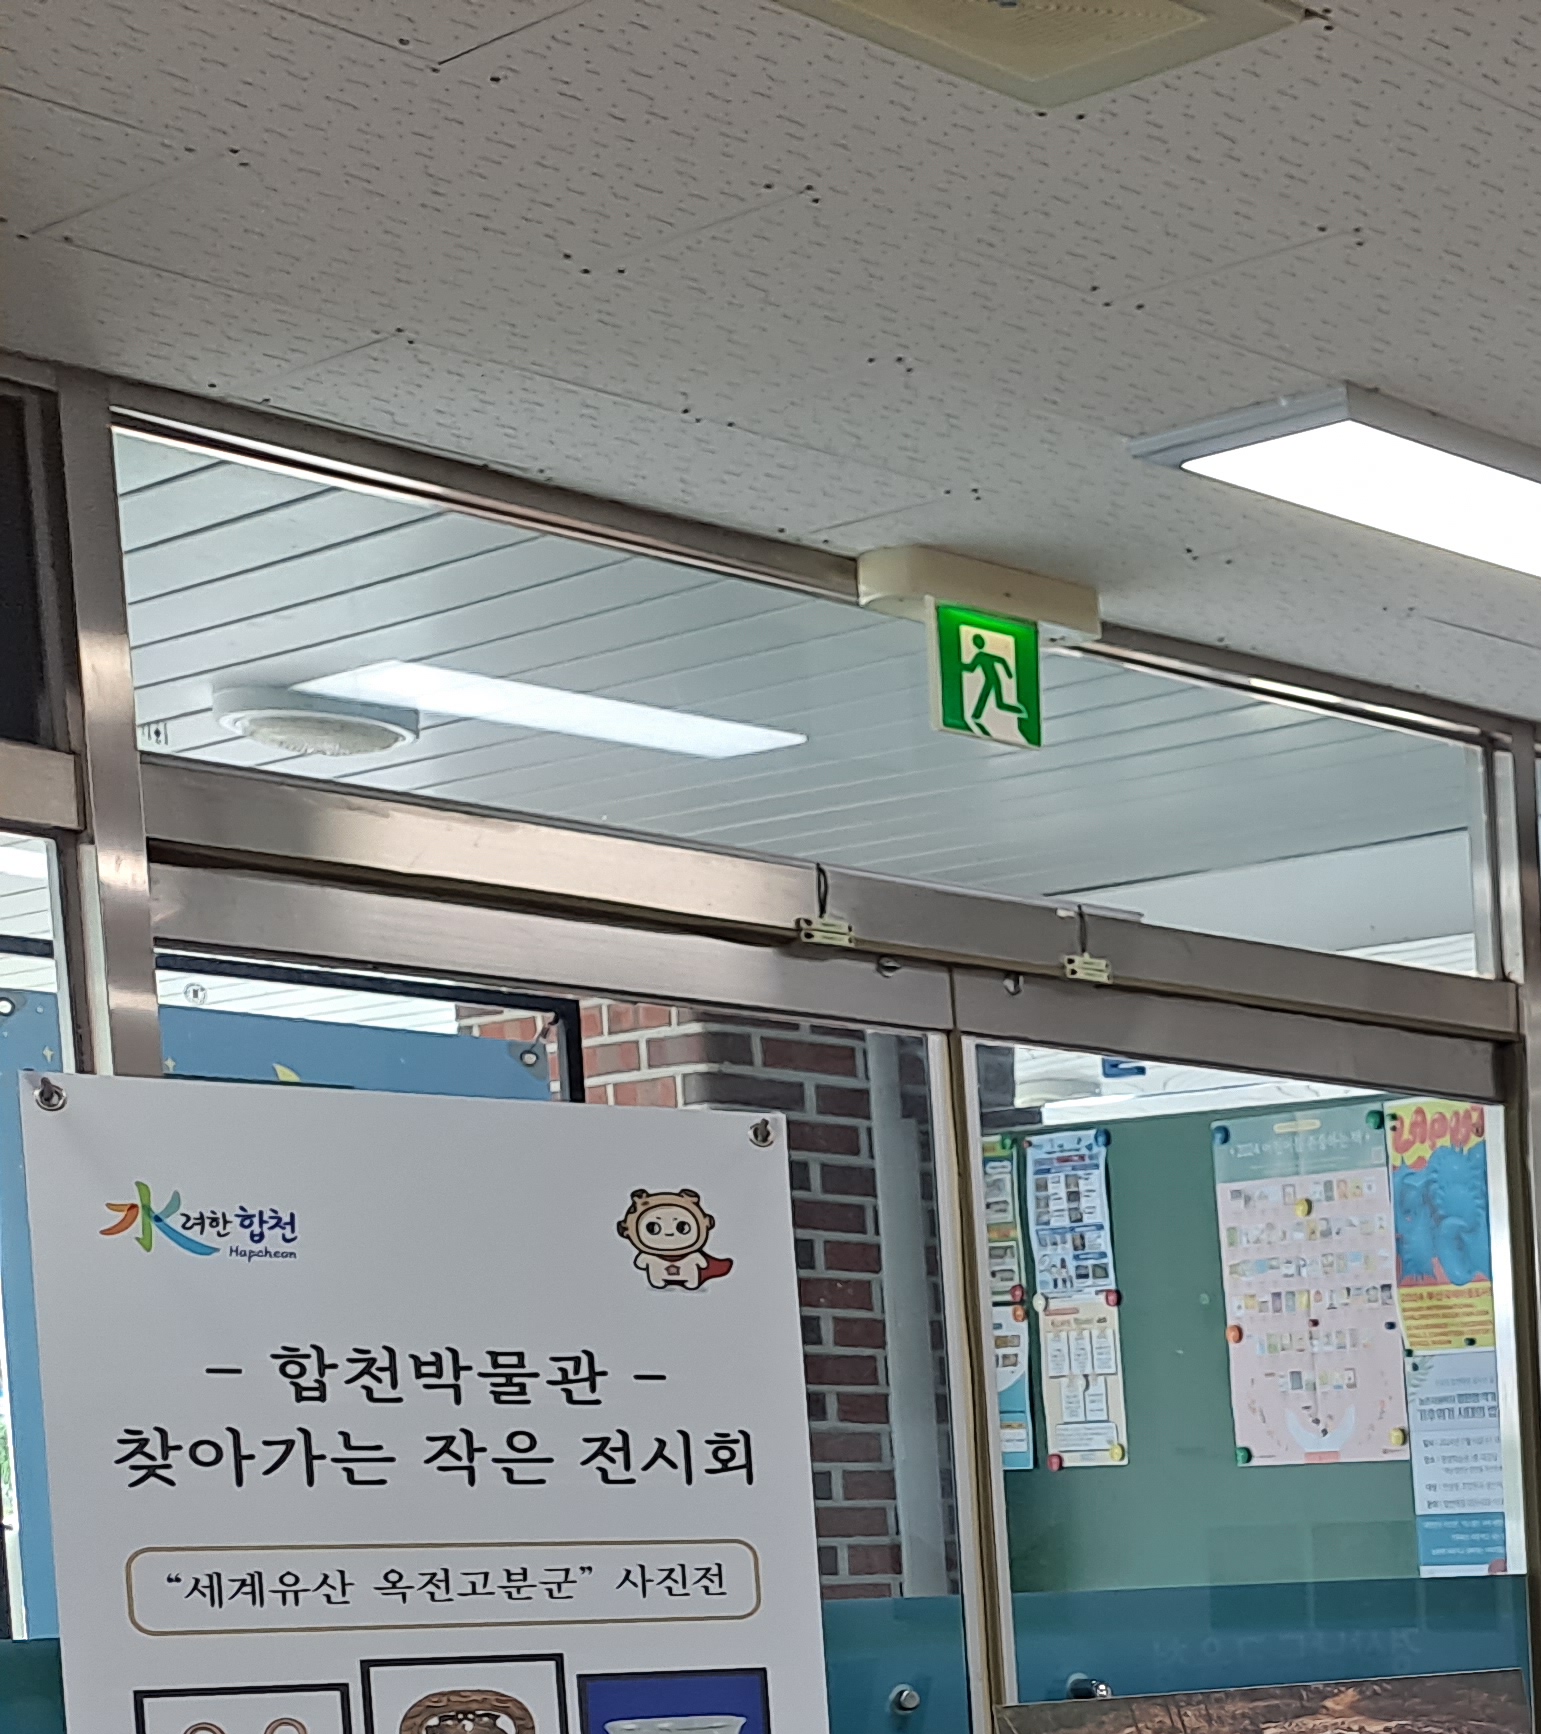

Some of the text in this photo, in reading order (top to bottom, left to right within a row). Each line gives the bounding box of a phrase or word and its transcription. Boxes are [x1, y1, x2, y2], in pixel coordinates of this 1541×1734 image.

[234, 1205, 298, 1243] 합천
[229, 1246, 297, 1262] Hapcheon
[270, 1344, 608, 1406] 합천박물관
[114, 1426, 753, 1488] 찾아가는 작은 전시회
[616, 1563, 727, 1598] 사진전
